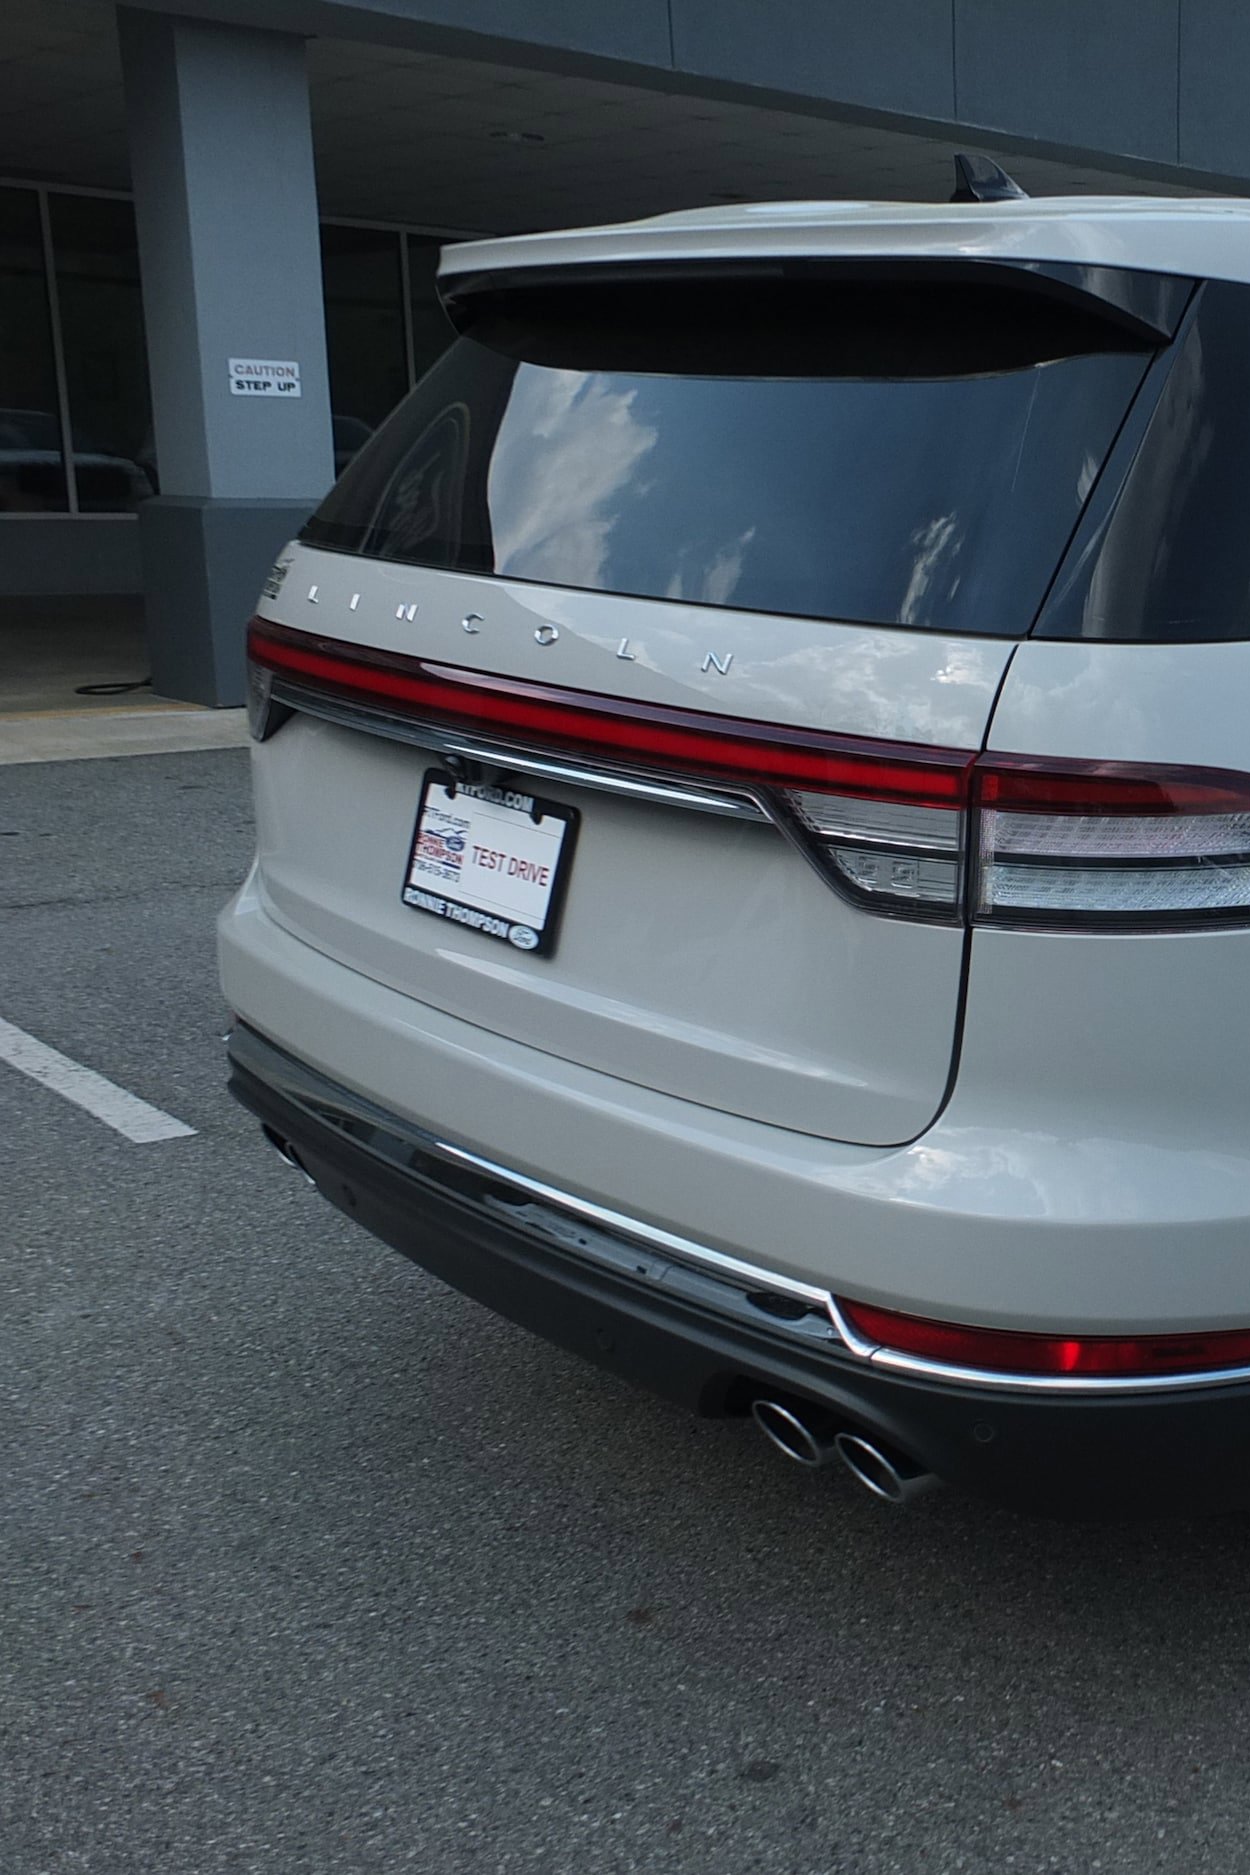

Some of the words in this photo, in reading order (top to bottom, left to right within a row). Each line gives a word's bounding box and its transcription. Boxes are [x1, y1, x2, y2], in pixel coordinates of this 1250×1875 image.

[234, 364, 295, 377] CAUTION
[235, 380, 272, 392] STEP
[277, 381, 296, 392] UP
[307, 584, 734, 675] LINCOLN
[472, 845, 505, 871] TEST
[507, 857, 550, 888] DRIVE
[445, 902, 510, 938] THOMPSON
